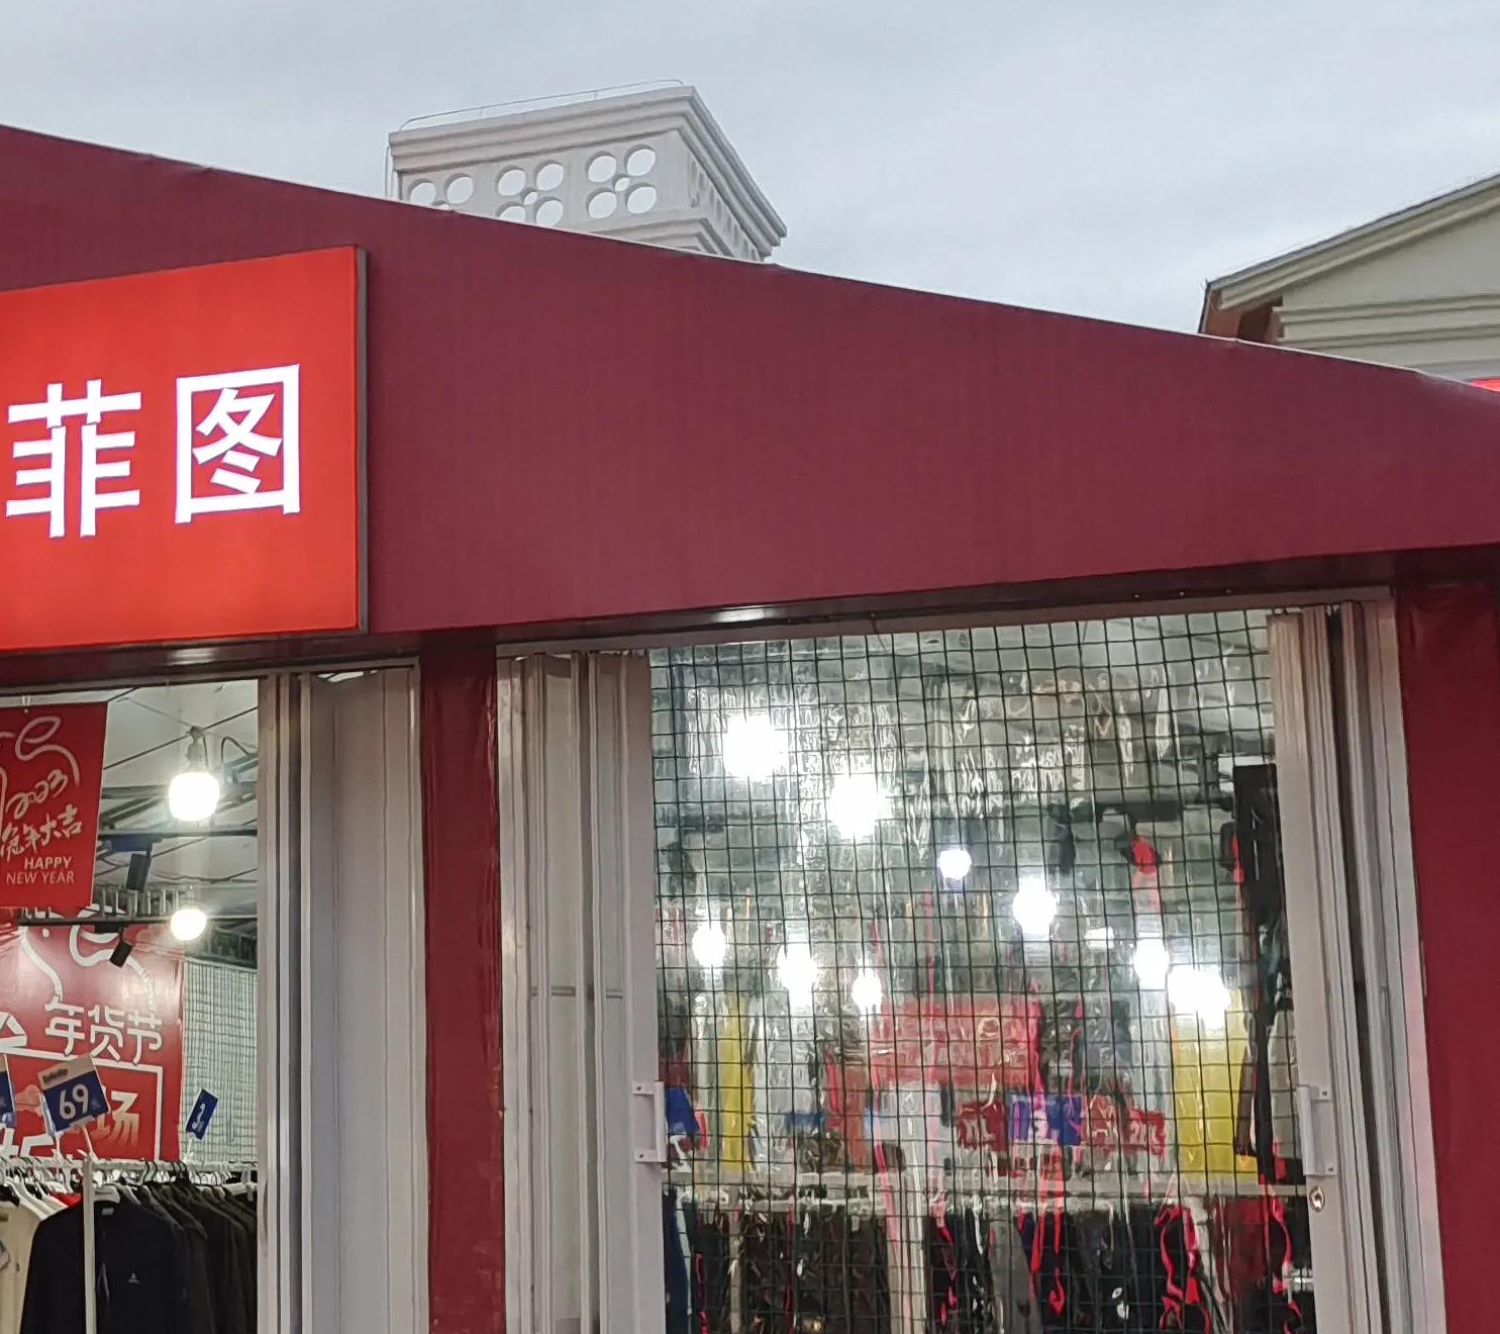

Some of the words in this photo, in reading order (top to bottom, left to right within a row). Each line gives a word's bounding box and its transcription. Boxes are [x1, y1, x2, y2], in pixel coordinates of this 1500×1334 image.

[23, 855, 72, 870] HAPPY
[6, 870, 39, 885] NEW
[41, 870, 75, 884] YEAR
[44, 992, 164, 1066] 年货节
[58, 1083, 89, 1120] 69
